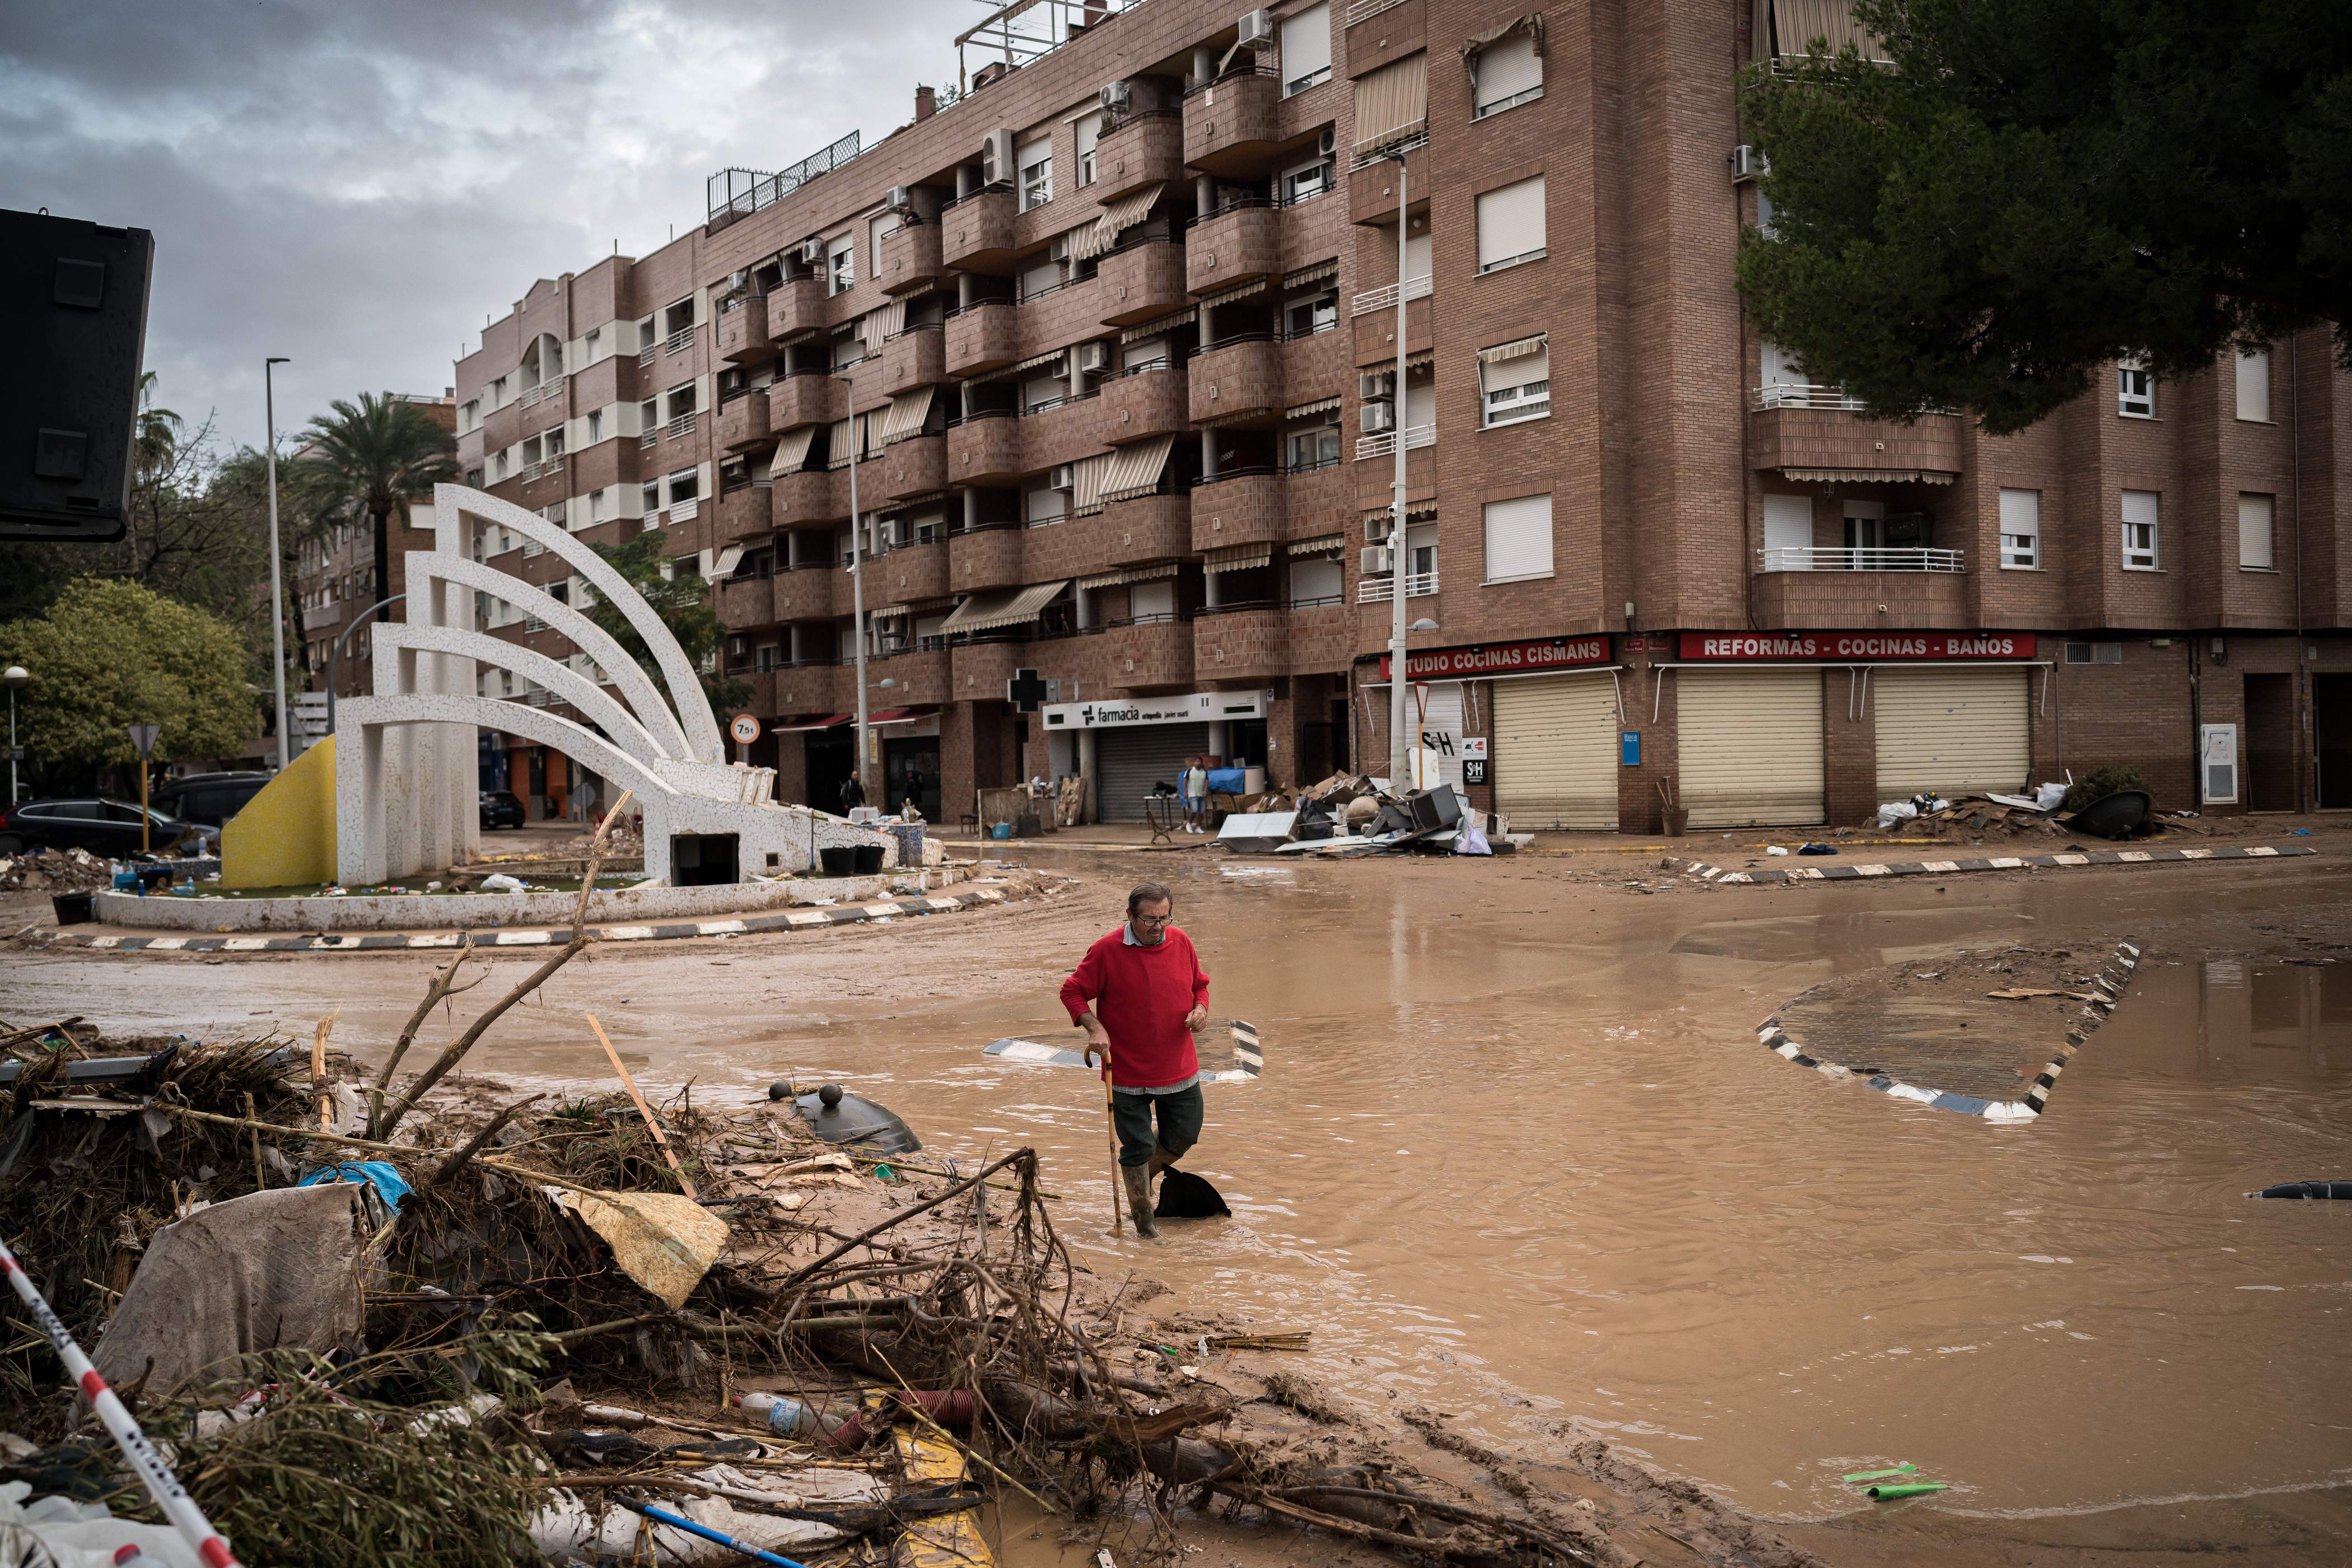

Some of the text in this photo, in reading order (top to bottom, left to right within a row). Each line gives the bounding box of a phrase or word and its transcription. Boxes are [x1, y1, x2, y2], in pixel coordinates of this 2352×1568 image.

[1705, 639, 1817, 655] REFORMAS
[1838, 638, 1927, 655] COCINAS
[1389, 642, 1600, 675] TUDIO COCINAS CISMANS
[1098, 705, 1139, 722] farmacia
[737, 725, 750, 734] 7,5
